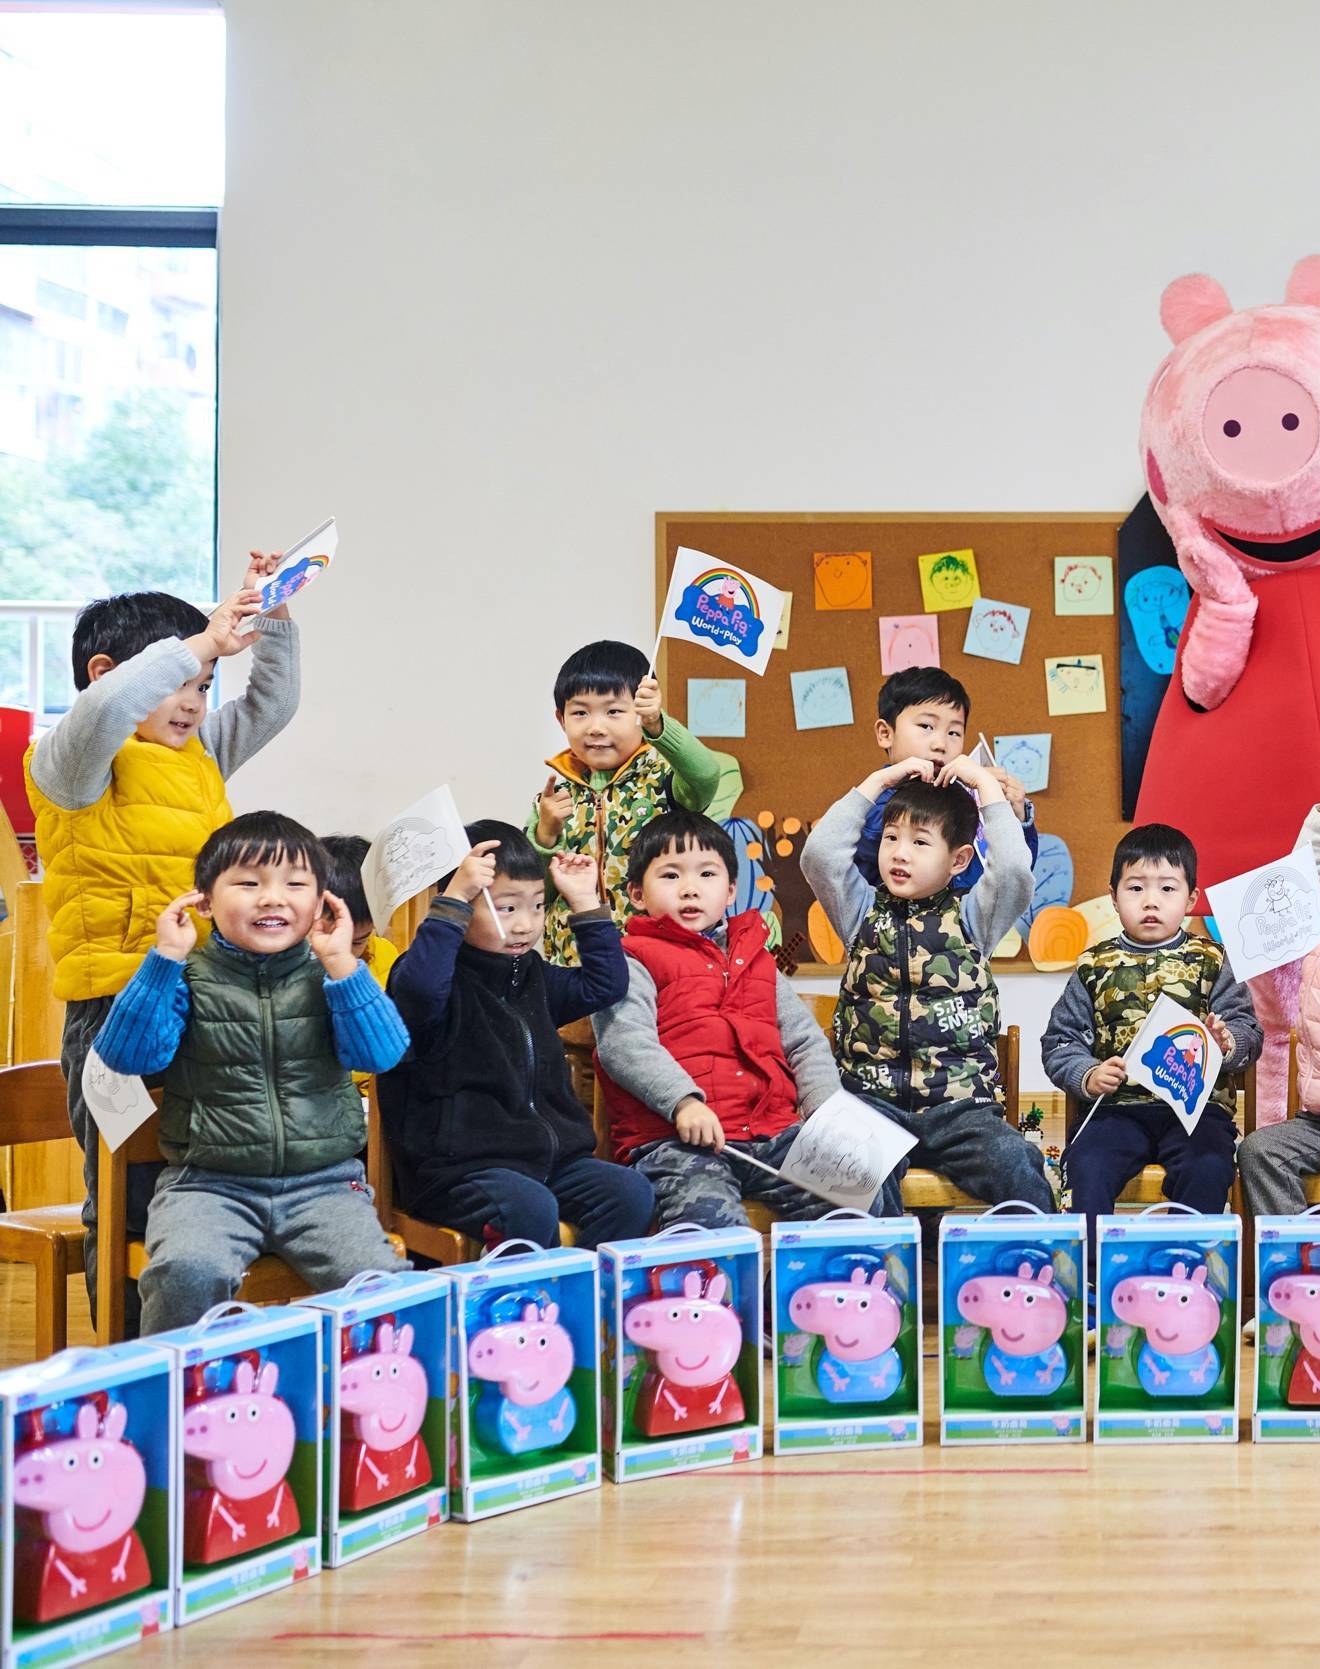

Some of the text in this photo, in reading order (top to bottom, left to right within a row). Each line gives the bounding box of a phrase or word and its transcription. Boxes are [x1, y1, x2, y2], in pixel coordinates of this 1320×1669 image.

[691, 616, 720, 635] World
[723, 630, 742, 645] Play
[696, 594, 748, 635] Peppa Pig
[1255, 916, 1298, 939] Peppa
[1155, 1065, 1179, 1089] World
[1180, 1085, 1189, 1102] Play
[1163, 1046, 1197, 1094] Peppa Pig
